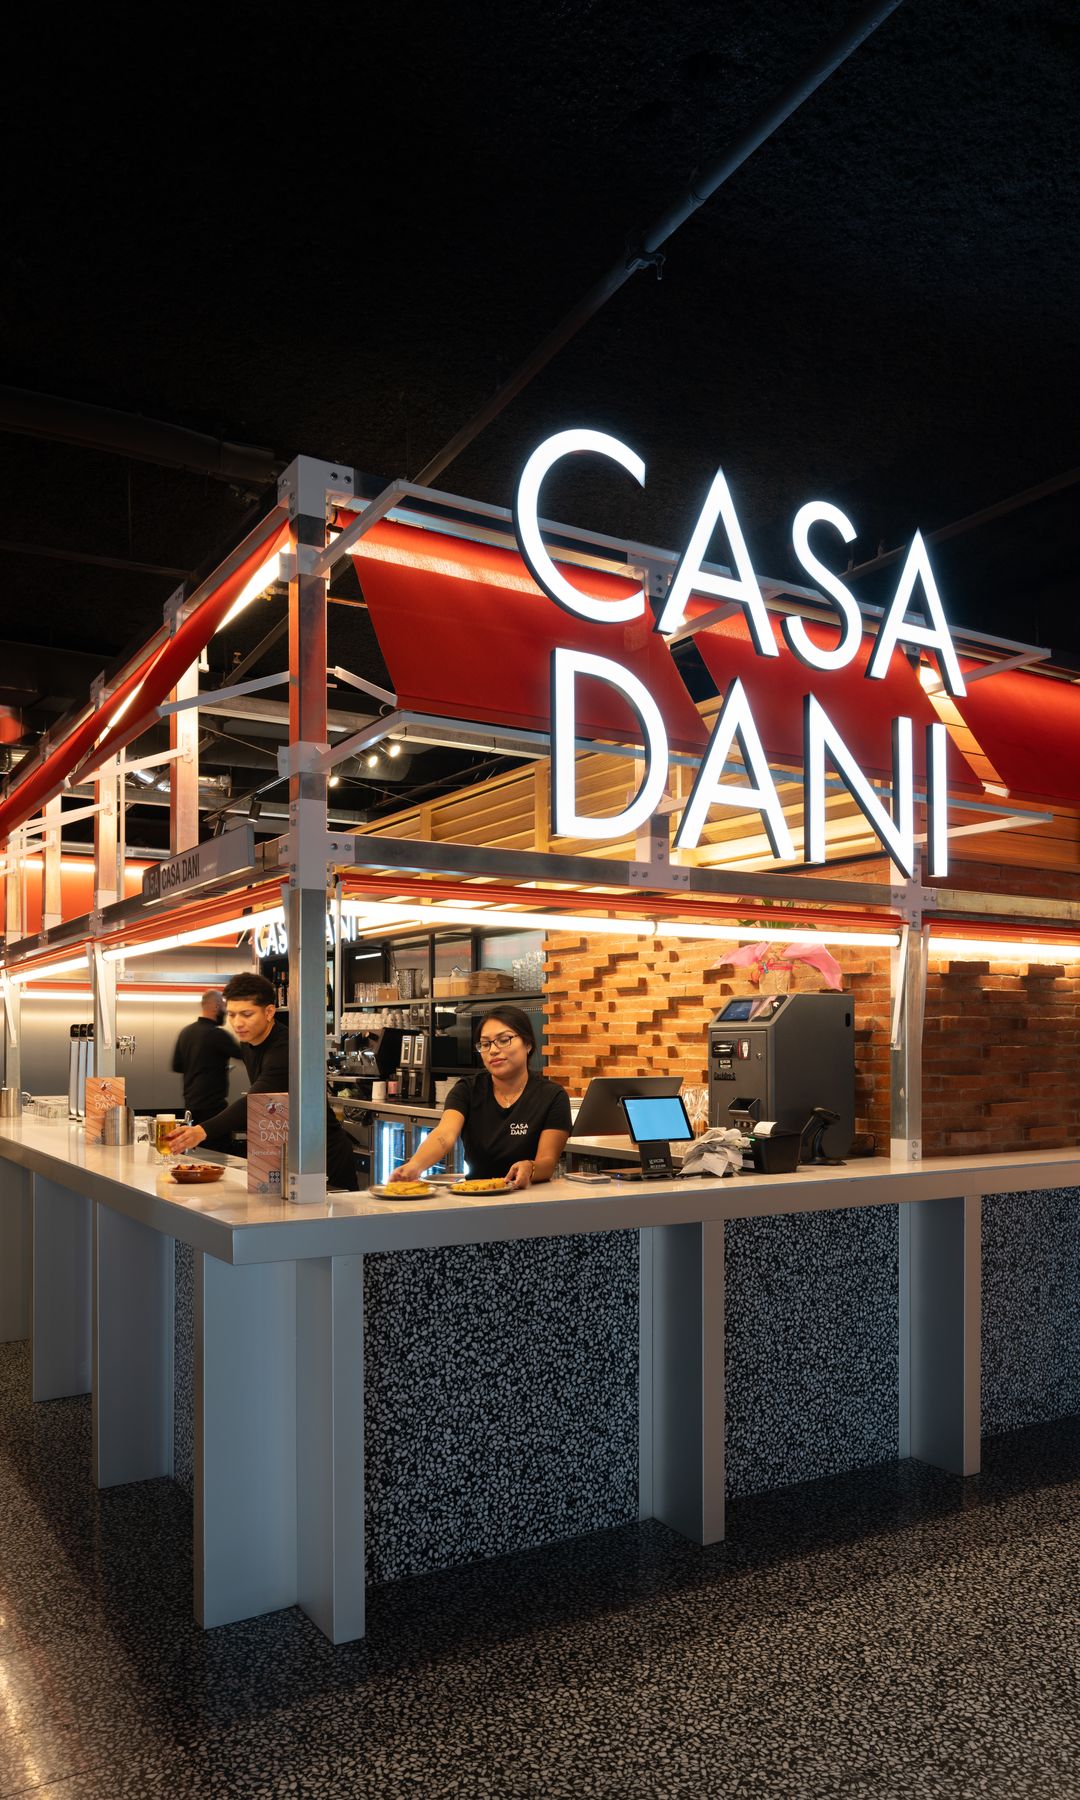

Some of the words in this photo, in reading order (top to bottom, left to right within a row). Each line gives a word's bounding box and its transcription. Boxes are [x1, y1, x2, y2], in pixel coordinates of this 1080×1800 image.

[512, 428, 968, 698] CASA
[550, 648, 949, 879] DANI
[161, 862, 180, 890] CASA
[182, 853, 200, 883] DANI
[254, 921, 288, 958] CAS
[325, 914, 356, 944] ANI
[258, 1119, 289, 1130] CASA
[509, 1122, 529, 1130] CASA
